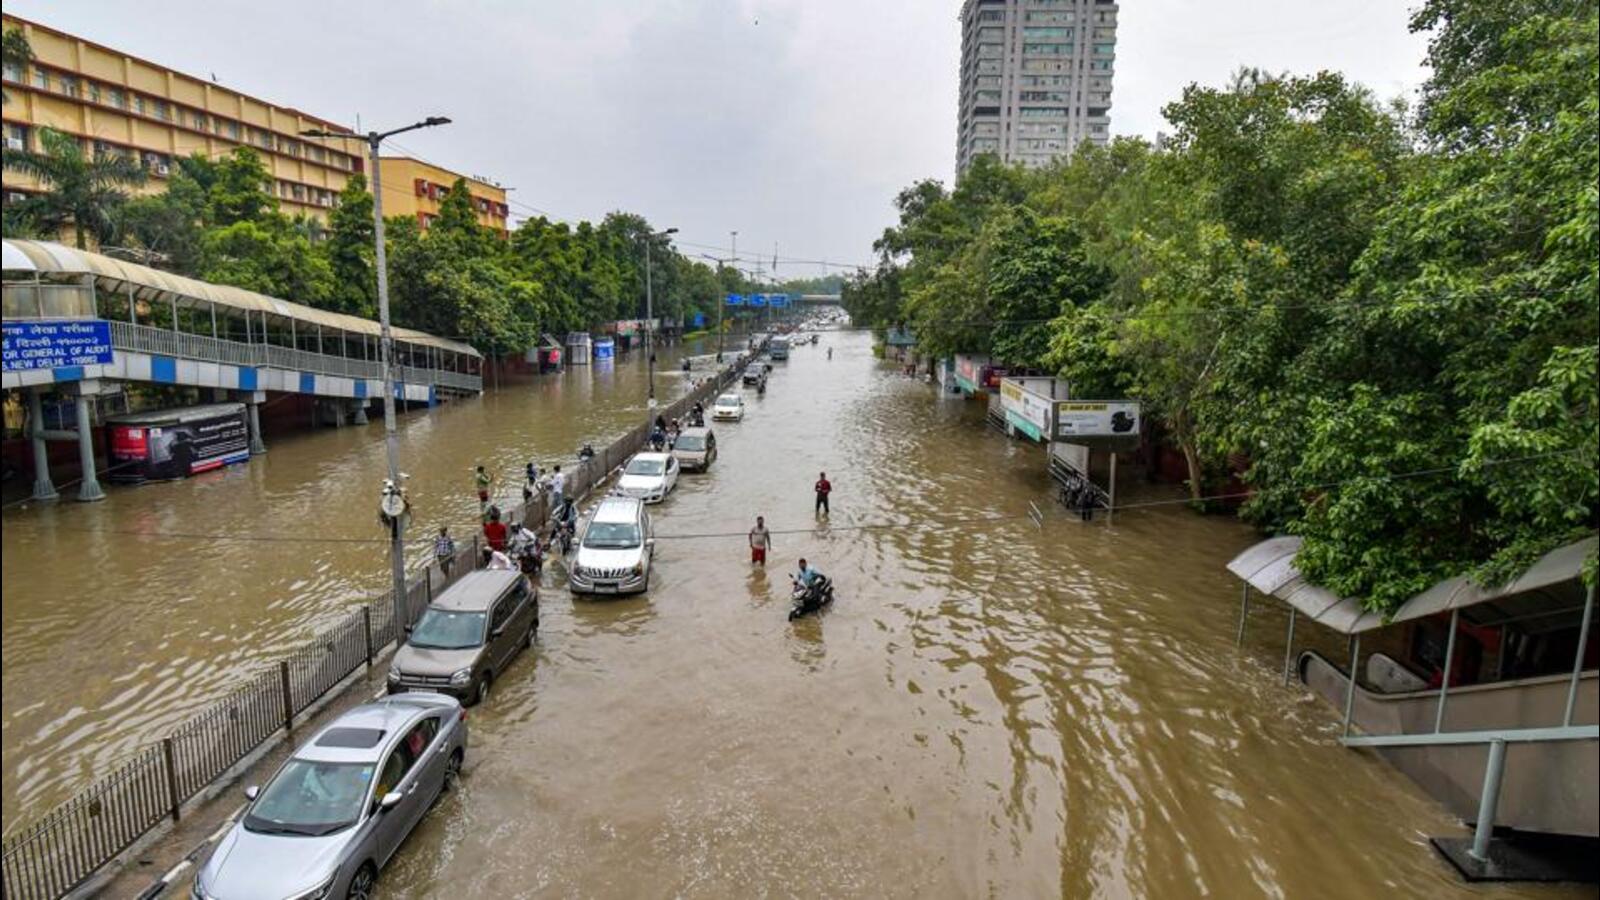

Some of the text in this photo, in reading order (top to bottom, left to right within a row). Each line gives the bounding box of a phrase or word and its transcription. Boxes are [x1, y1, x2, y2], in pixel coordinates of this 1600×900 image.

[21, 348, 67, 358] GENERAL
[70, 346, 82, 356] OF
[85, 345, 109, 354] AUDIT
